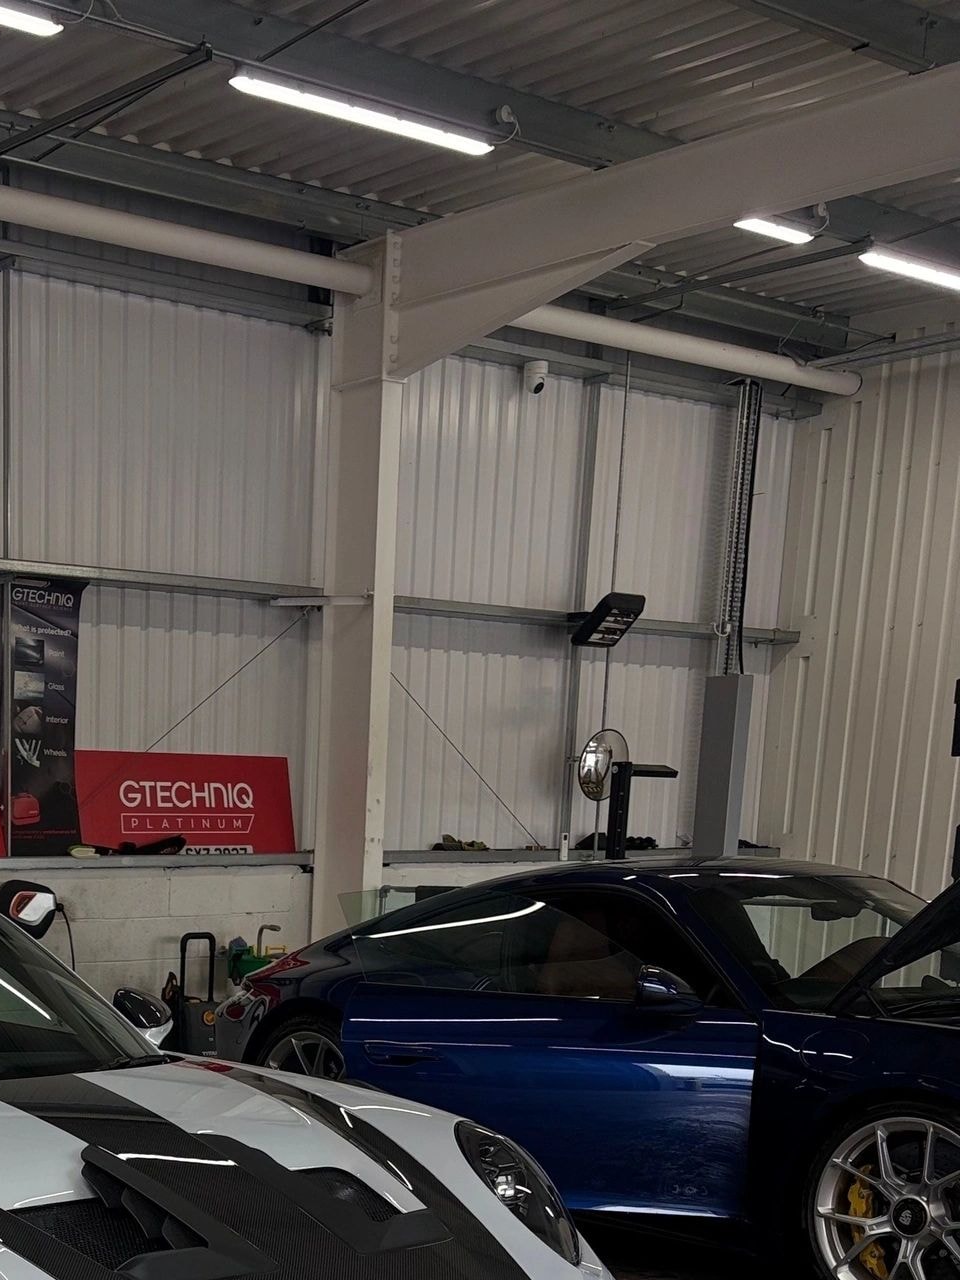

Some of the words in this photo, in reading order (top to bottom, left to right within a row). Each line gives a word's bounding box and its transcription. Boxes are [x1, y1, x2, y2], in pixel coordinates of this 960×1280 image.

[12, 588, 74, 607] GTECHNIQ
[48, 649, 65, 657] Paint
[48, 682, 65, 691] Glass
[45, 715, 68, 724] Interior
[43, 748, 67, 757] Wheels
[119, 780, 254, 809] GTECHNIQ
[131, 818, 242, 829] PLATINUM
